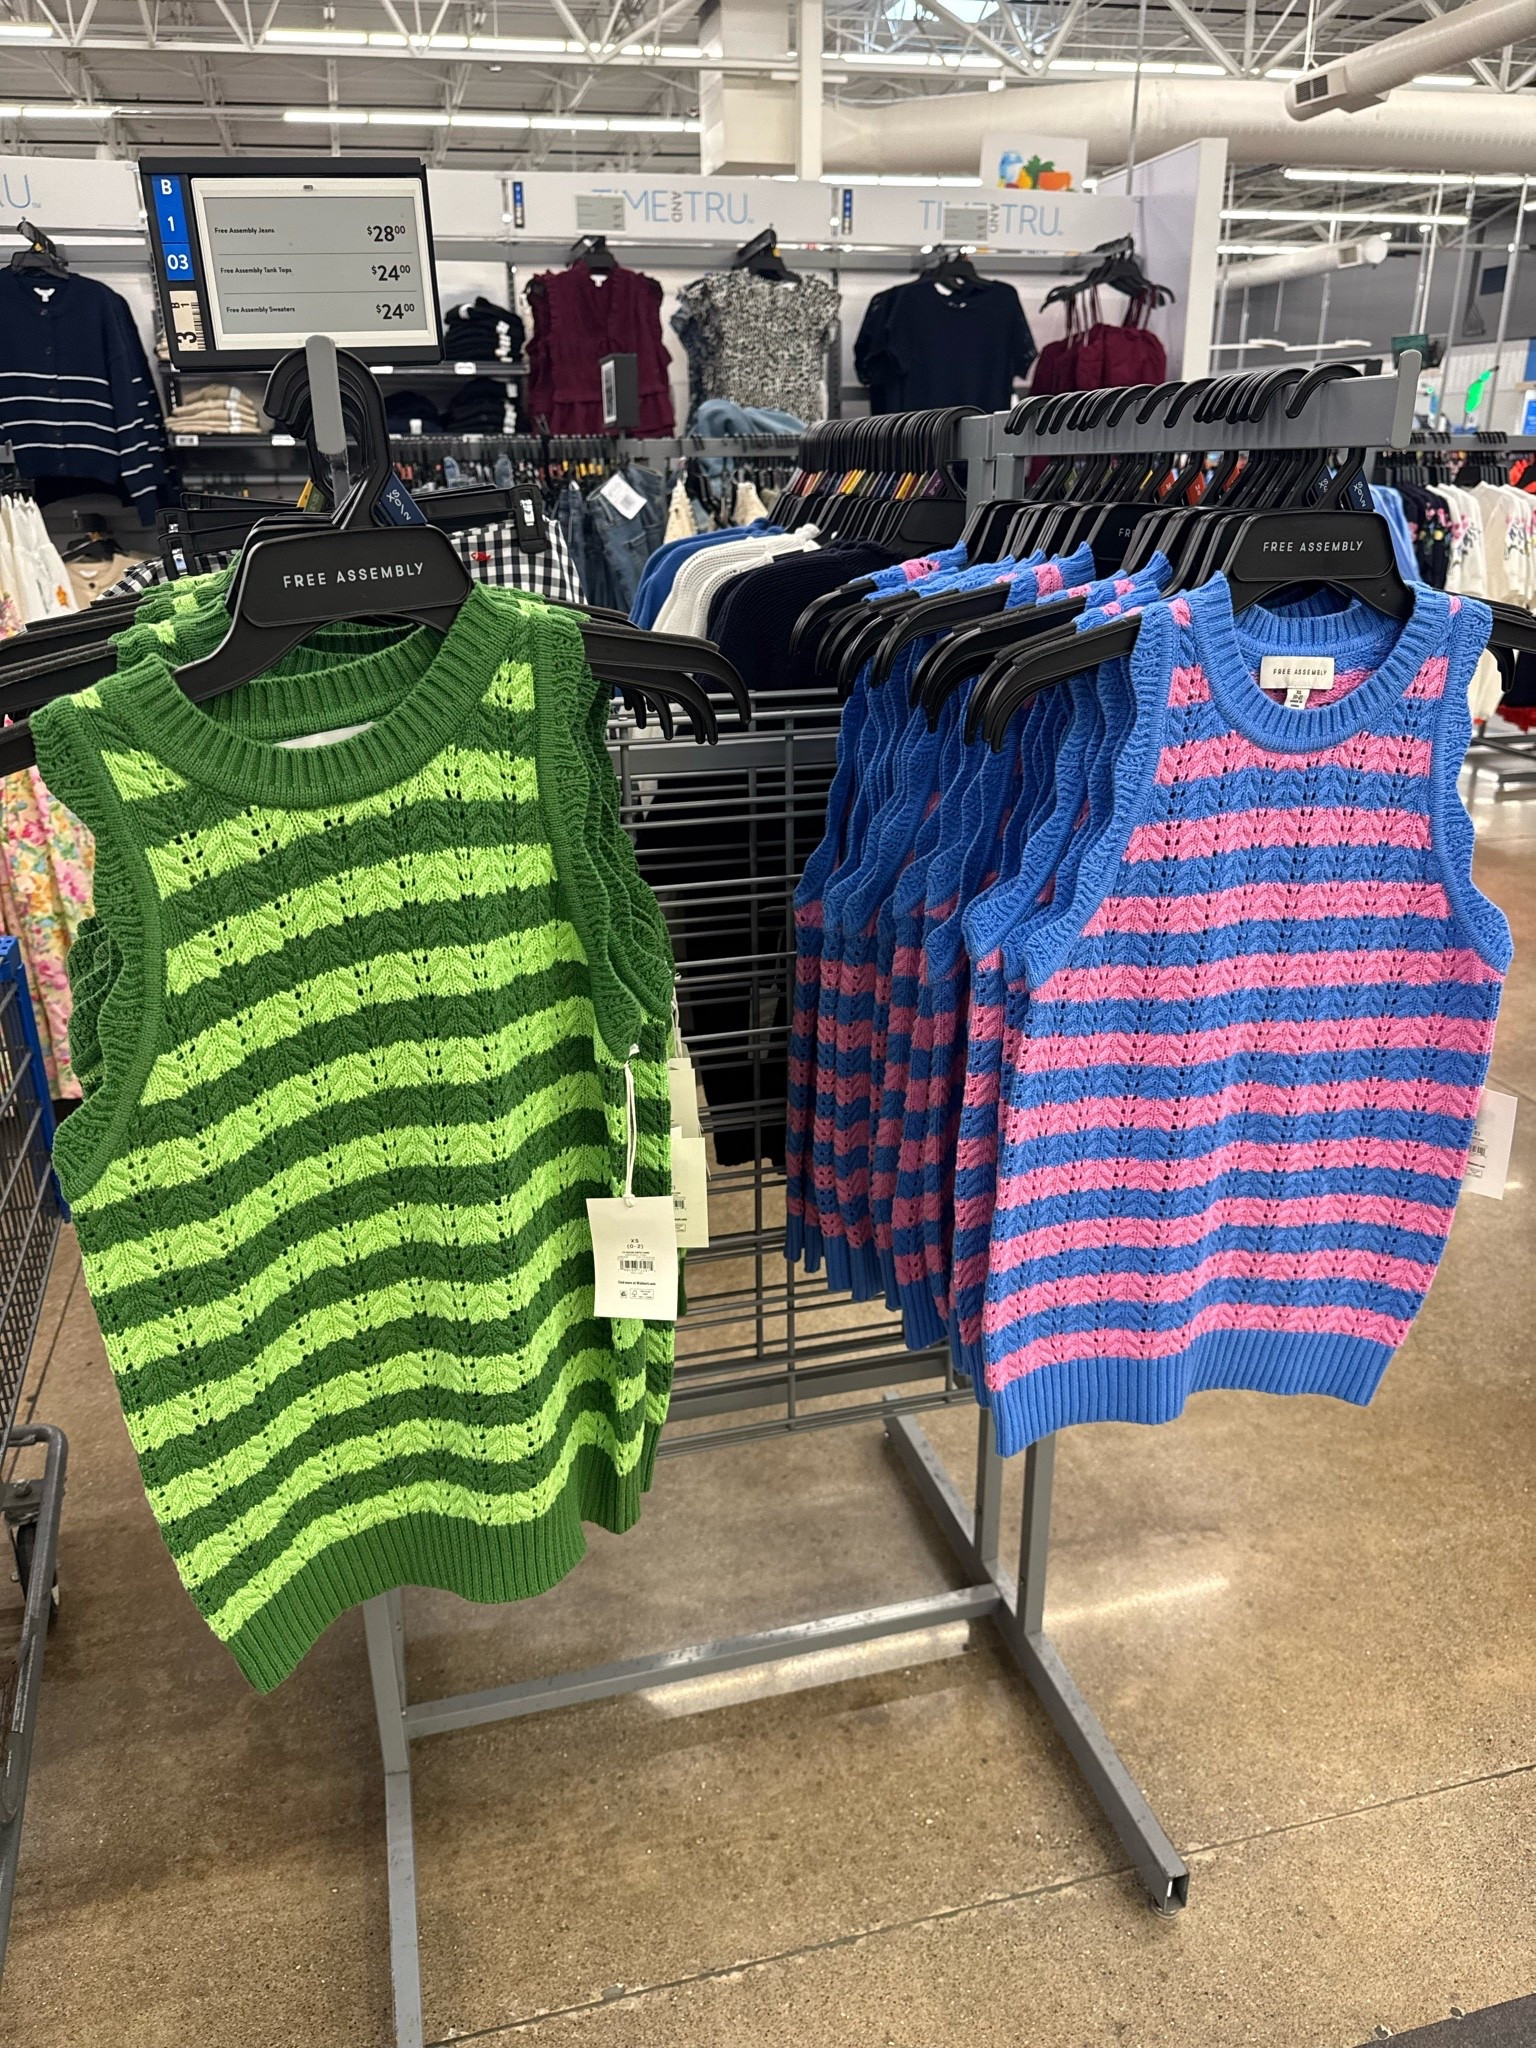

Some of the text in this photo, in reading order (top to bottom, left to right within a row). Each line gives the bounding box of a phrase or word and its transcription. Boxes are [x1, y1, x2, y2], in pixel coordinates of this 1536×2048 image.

[160, 179, 173, 195] B
[167, 215, 175, 232] 1
[229, 227, 257, 235] Assembly
[167, 254, 189, 270] 03
[235, 267, 263, 275] Assembly
[278, 266, 292, 275] Tops
[240, 306, 268, 314] Assembly
[176, 331, 197, 344] 3
[1353, 481, 1364, 492] XS
[386, 489, 400, 502] XS
[1263, 541, 1363, 552] FREE ASSEMBLY
[283, 562, 424, 588] FREE ASSEMBLY
[1294, 668, 1328, 676] ASSEMBLY
